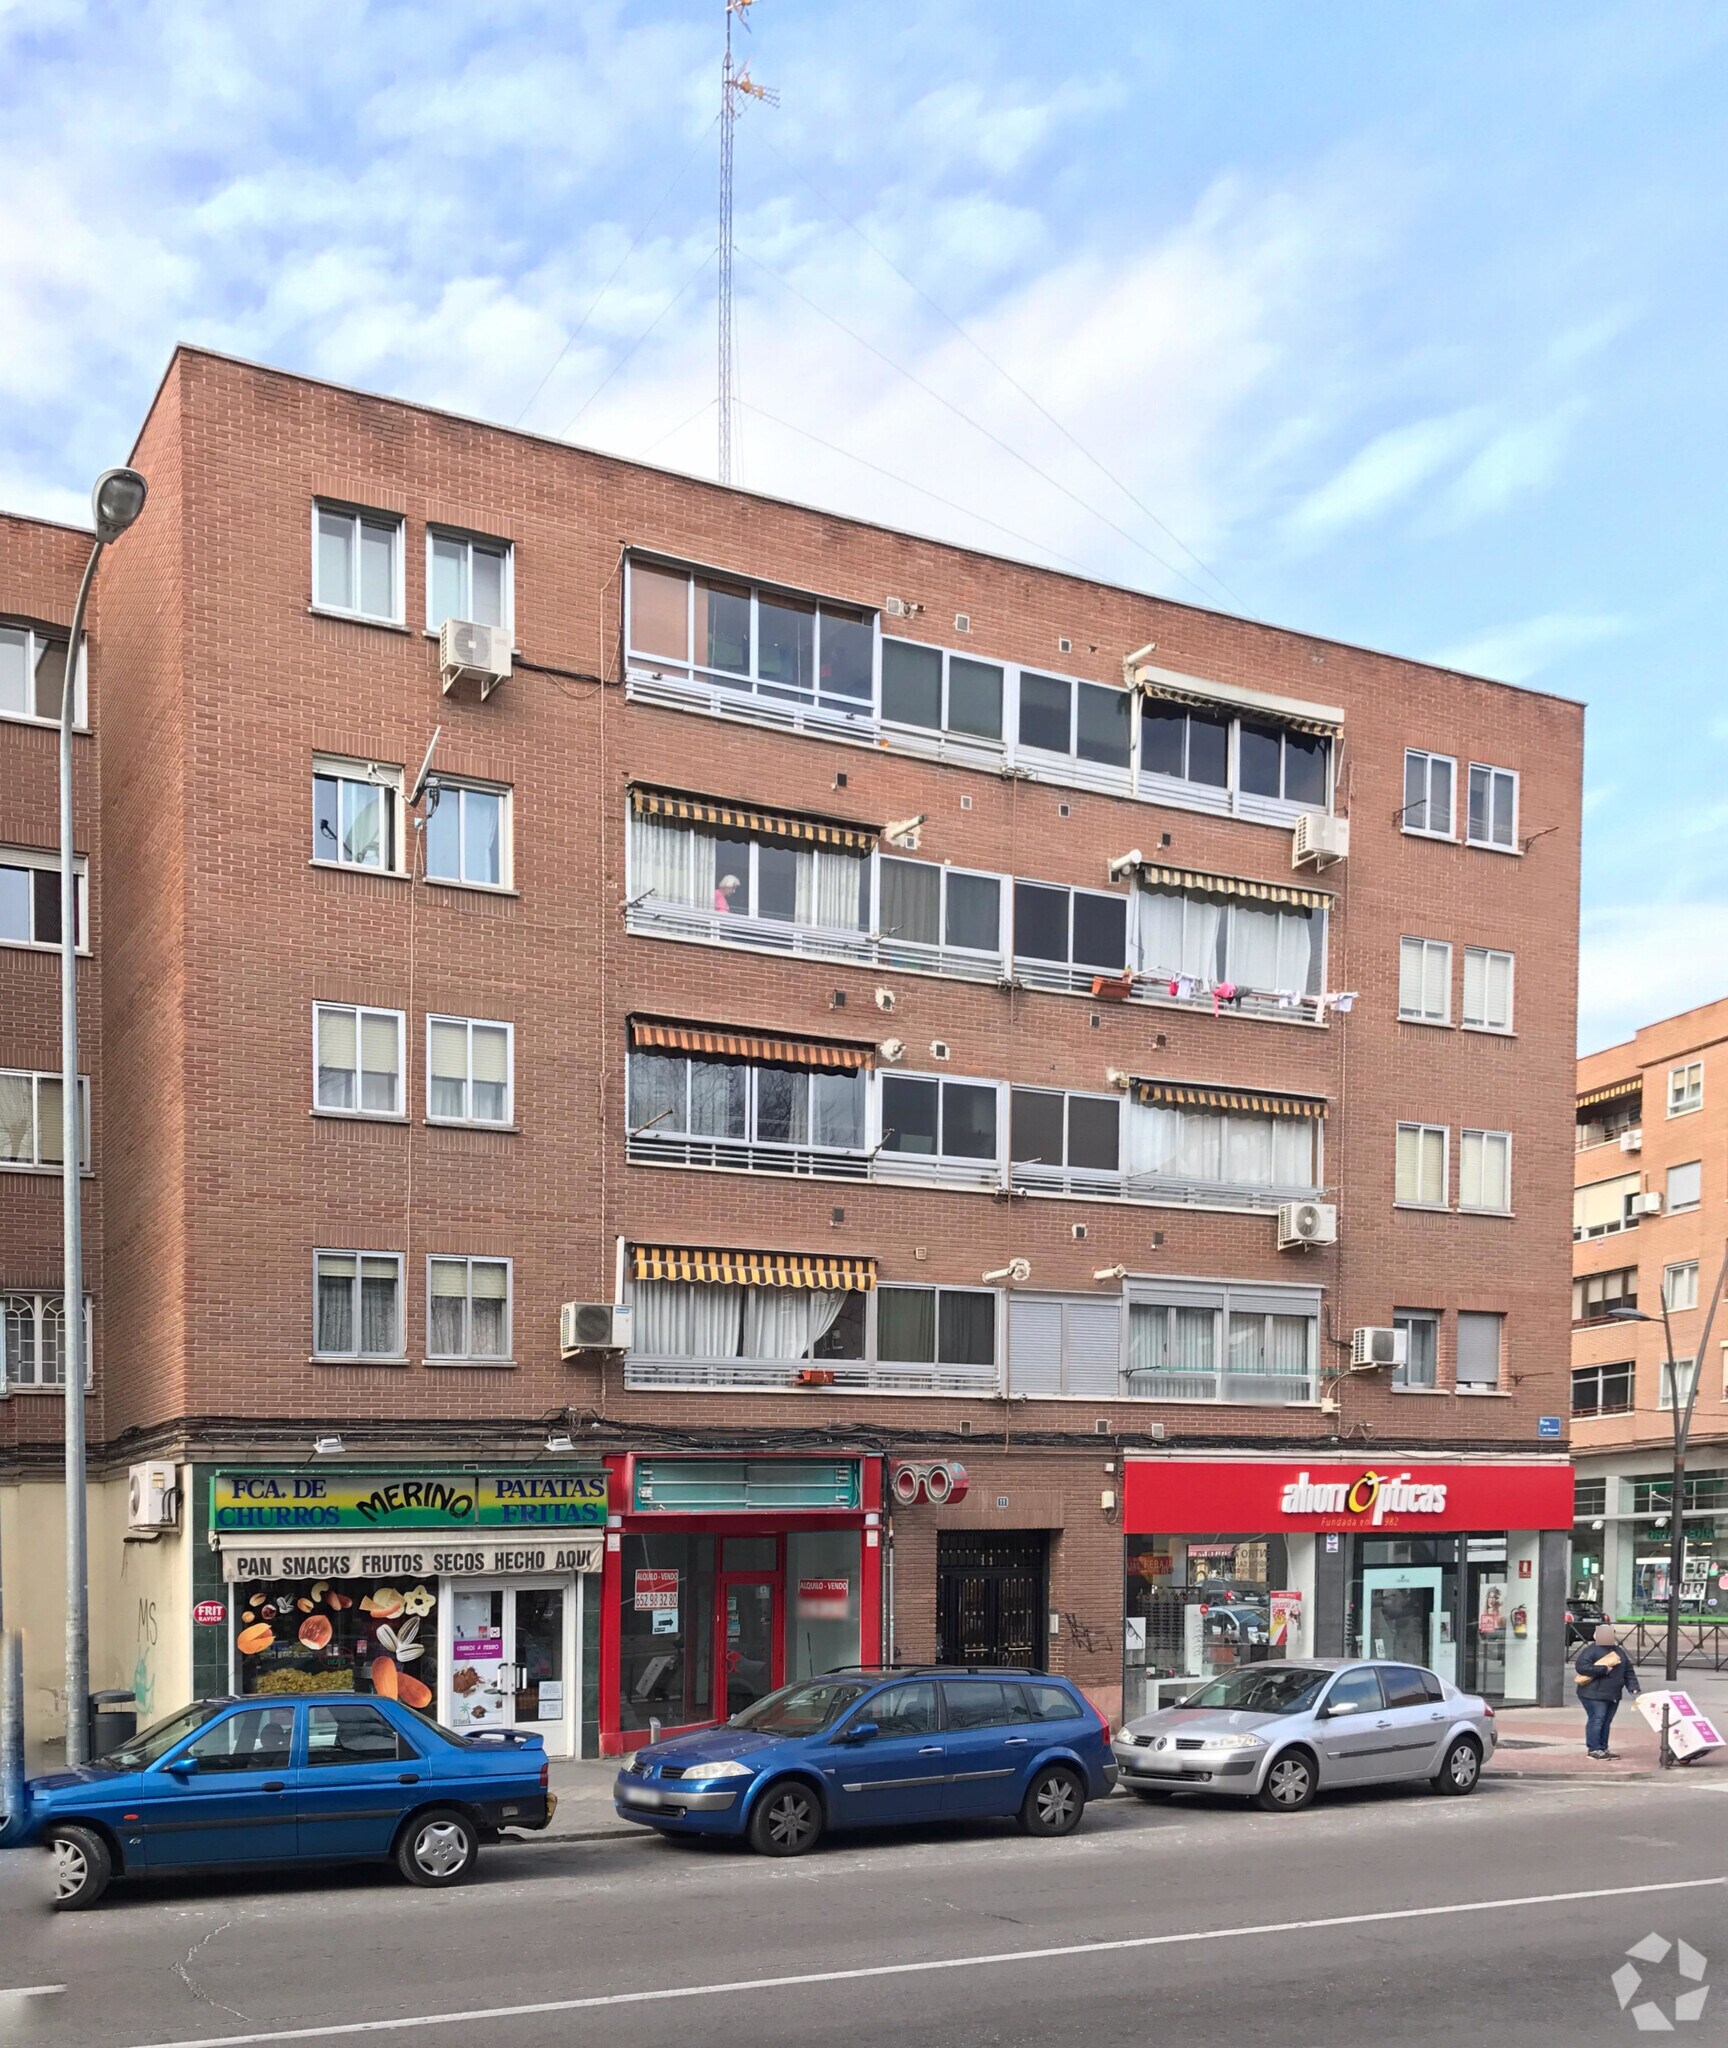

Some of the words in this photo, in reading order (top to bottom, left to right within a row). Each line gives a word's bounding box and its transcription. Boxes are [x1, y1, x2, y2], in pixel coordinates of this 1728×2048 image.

[232, 1479, 287, 1499] FCA.
[293, 1479, 327, 1499] DE
[495, 1478, 605, 1499] PATATAS
[356, 1481, 473, 1522] MERINO
[217, 1506, 341, 1527] CHURROS
[501, 1502, 599, 1523] FRITAS
[1321, 1517, 1357, 1527] Fundada
[237, 1557, 272, 1576] PAN
[282, 1555, 351, 1575] SNACKS
[362, 1553, 423, 1573] FRUTOS
[433, 1552, 485, 1572] SECOS
[494, 1550, 546, 1571] HECHO
[636, 1572, 658, 1581] ALQUILO
[661, 1572, 679, 1581] VENDO
[800, 1582, 823, 1590] ALQUILO
[827, 1582, 848, 1590] VENDO
[636, 1593, 648, 1607] 652
[659, 1593, 668, 1606] 32
[198, 1605, 223, 1616] FRIT
